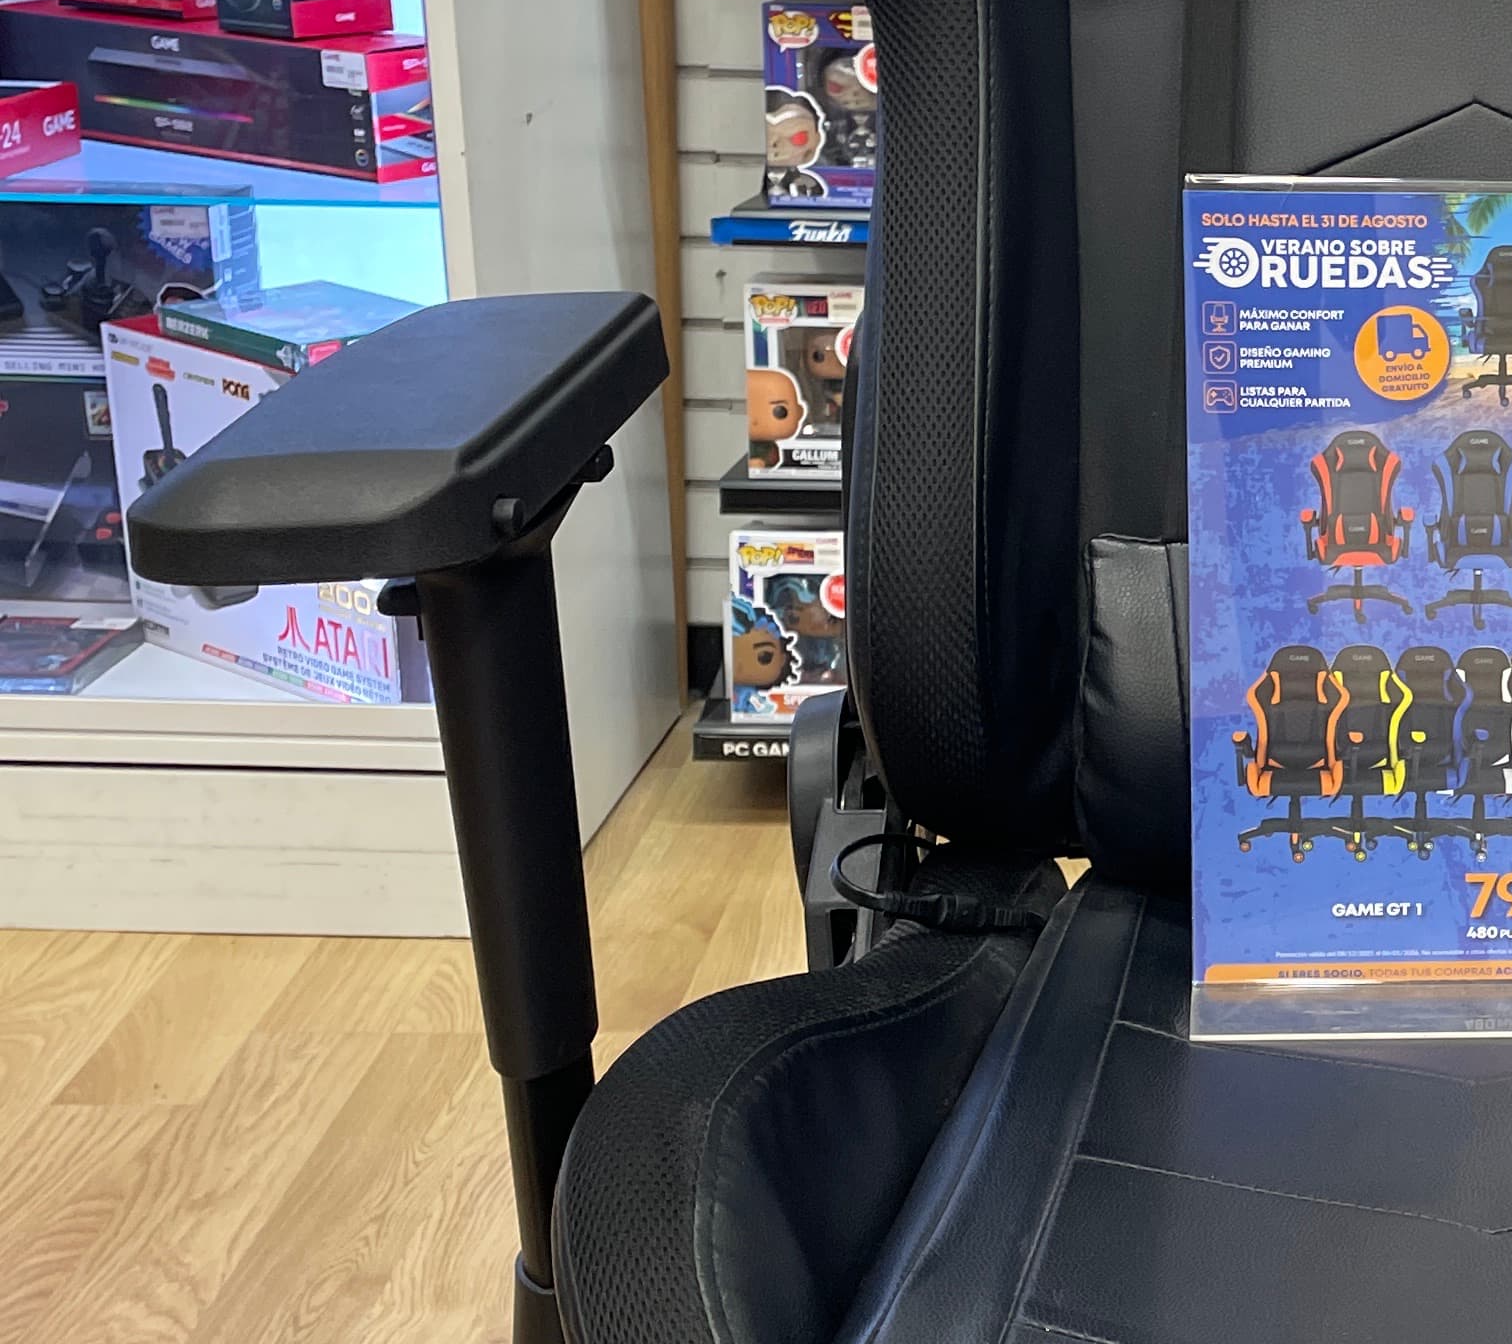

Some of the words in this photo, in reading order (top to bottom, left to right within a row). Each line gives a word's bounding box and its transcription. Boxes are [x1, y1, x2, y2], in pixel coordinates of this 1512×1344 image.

[42, 108, 76, 137] GAME
[1202, 213, 1245, 227] SOLO
[1248, 214, 1299, 227] HASTA
[1302, 215, 1319, 227] EL
[1321, 215, 1335, 228] 31
[1339, 215, 1358, 227] DE
[1361, 215, 1428, 229] AGOSTO
[788, 221, 852, 243] Funko
[1261, 239, 1345, 256] VERANO
[1350, 240, 1416, 256] SOBRE
[1261, 256, 1433, 289] RUEDAS
[750, 294, 798, 317] POP!
[1239, 307, 1287, 321] MÁXIMO
[1290, 310, 1345, 320] CONFORT
[1239, 321, 1268, 331] PARA
[1271, 321, 1311, 331] GANAR
[1239, 345, 1280, 358] DISEÑO
[1283, 348, 1331, 358] GAMING
[1239, 359, 1293, 369] PREMIUM
[1385, 362, 1415, 373] ENVÍO
[1378, 374, 1431, 383] DOMICILIO
[221, 377, 250, 402] PONG
[1240, 387, 1275, 397] LISTAS
[1278, 387, 1307, 397] PARA
[1381, 383, 1430, 393] GRATUITO
[1240, 398, 1302, 409] CUALQUIER
[1304, 398, 1351, 409] PARTIDA
[314, 617, 391, 679] ATARI
[722, 742, 750, 757] PC
[1332, 902, 1385, 918] GAME
[1387, 903, 1410, 917] GT
[1414, 903, 1423, 917] 1
[1466, 925, 1498, 941] 480
[1293, 969, 1320, 979] ERES
[1369, 969, 1407, 978] TODAS
[1411, 968, 1431, 977] TUS
[1434, 967, 1492, 977] COMPRAS
